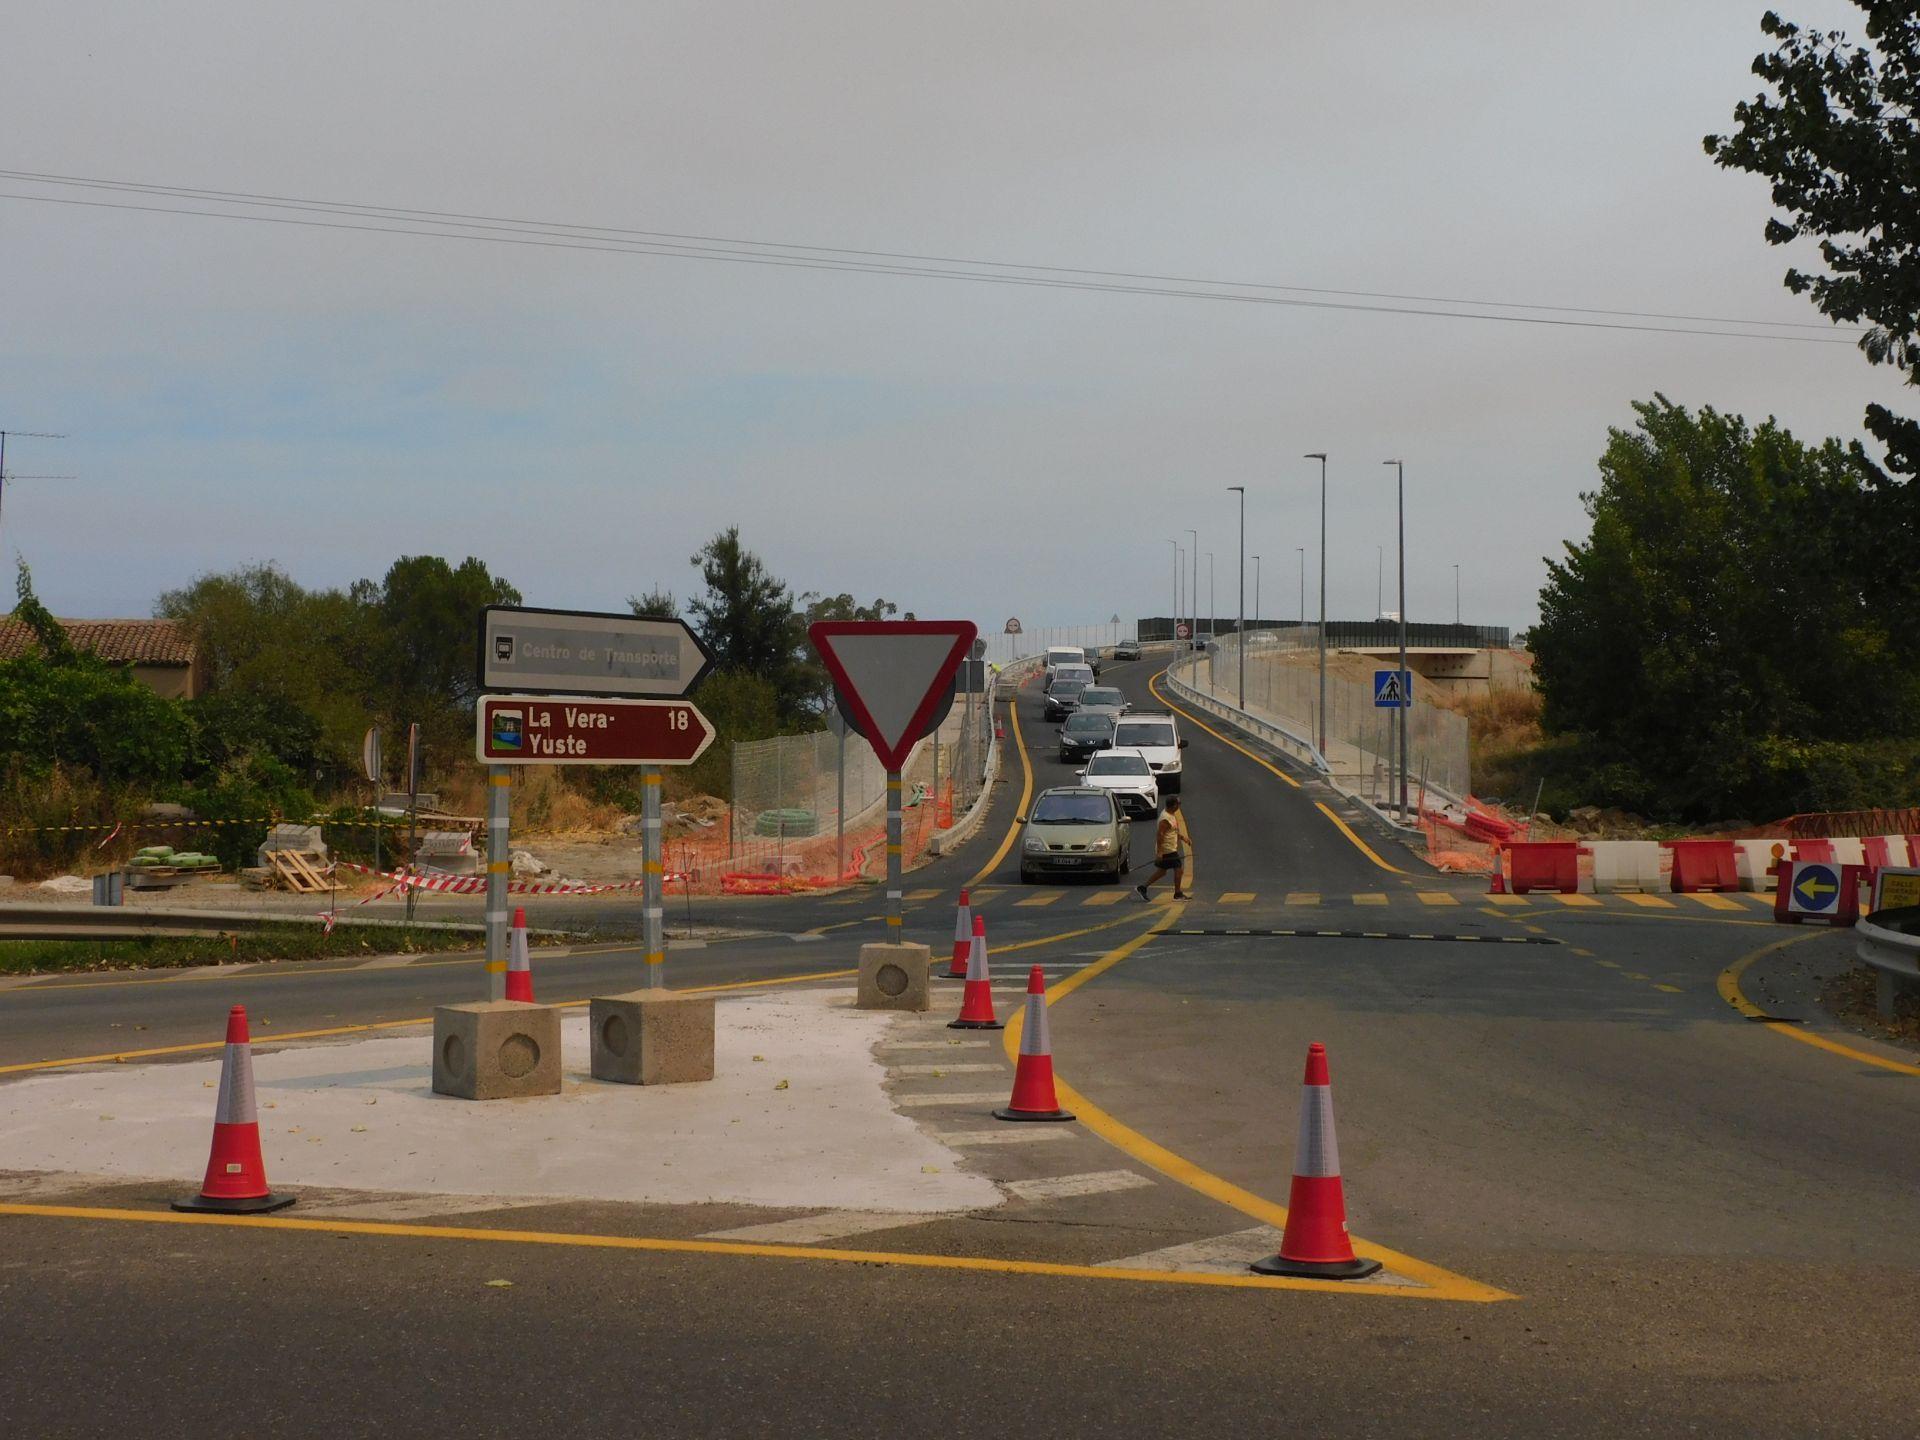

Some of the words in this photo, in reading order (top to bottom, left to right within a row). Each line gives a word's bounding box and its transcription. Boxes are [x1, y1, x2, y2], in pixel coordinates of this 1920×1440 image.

[522, 642, 570, 660] Centro
[578, 648, 596, 661] de
[606, 648, 677, 667] Transporte
[528, 706, 551, 727] La
[668, 710, 689, 731] 18
[529, 733, 587, 754] Yuste
